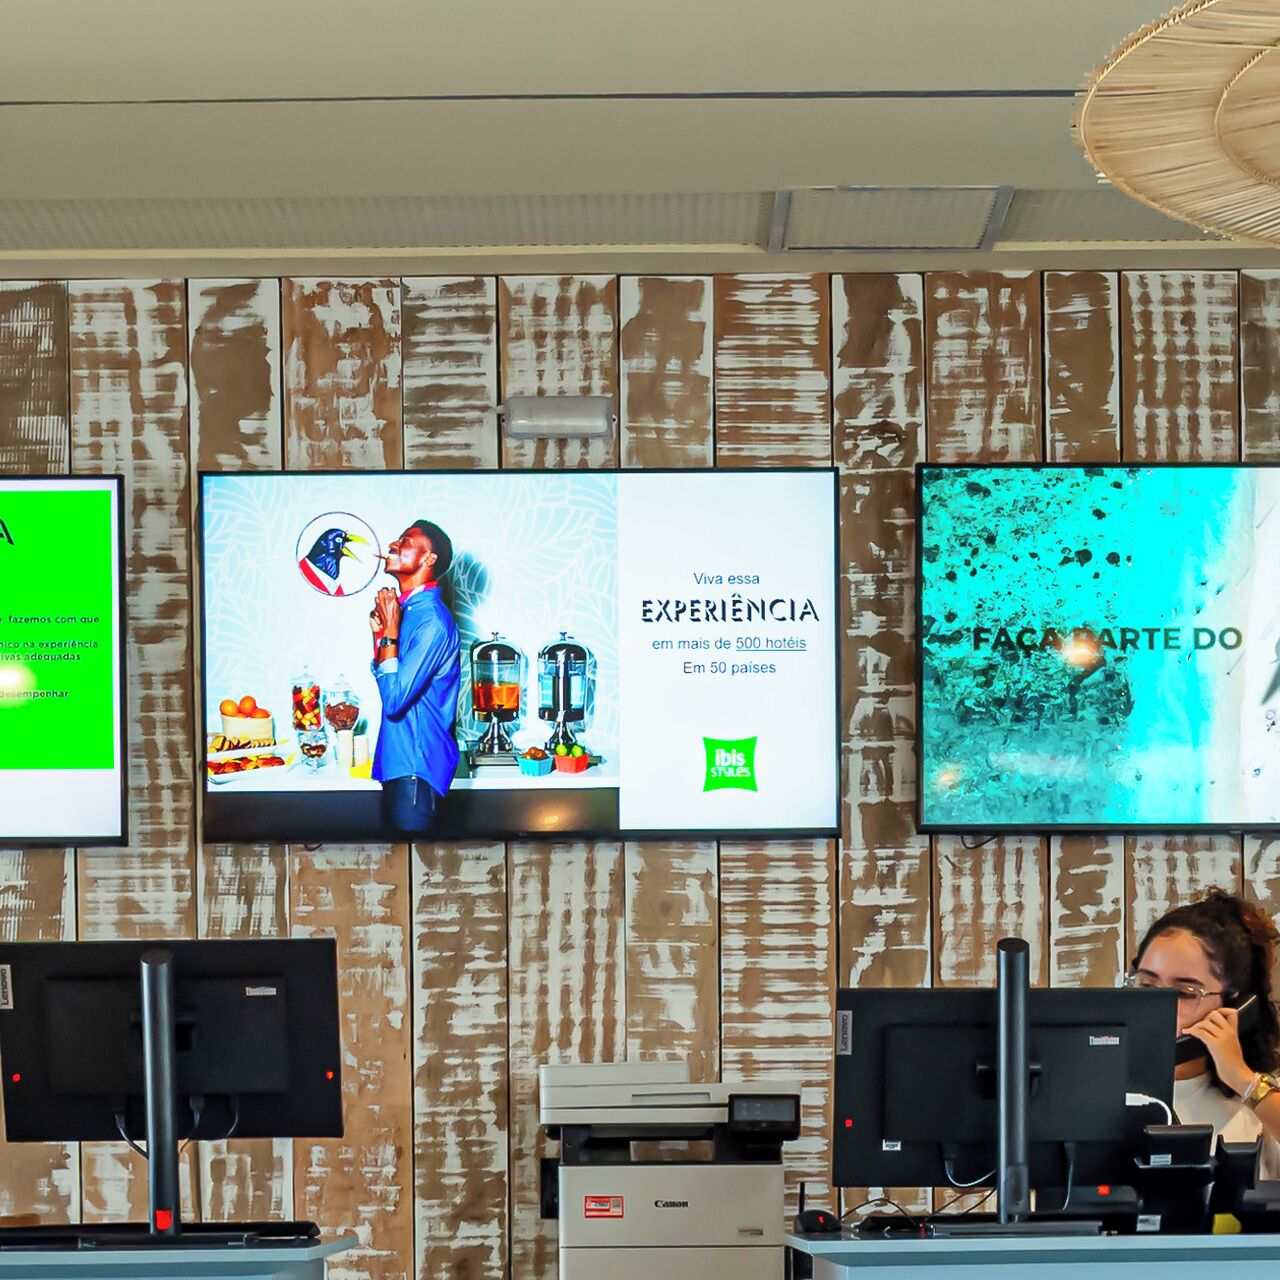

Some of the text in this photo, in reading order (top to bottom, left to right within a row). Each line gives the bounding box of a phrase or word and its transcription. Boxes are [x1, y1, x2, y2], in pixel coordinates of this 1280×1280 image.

[693, 572, 760, 585] Viva essa
[642, 593, 820, 622] EXPERIÊNCIA
[8, 615, 52, 623] fazemos
[79, 616, 100, 625] que
[38, 639, 99, 650] experiência
[652, 636, 807, 650] em mais de 500 hotéis
[973, 627, 1062, 658] FAÇA
[1194, 627, 1242, 650] DO
[23, 652, 81, 662] adequadas
[683, 661, 777, 676] Em 50 países
[715, 749, 746, 767] ibis
[654, 1200, 689, 1208] Canon
